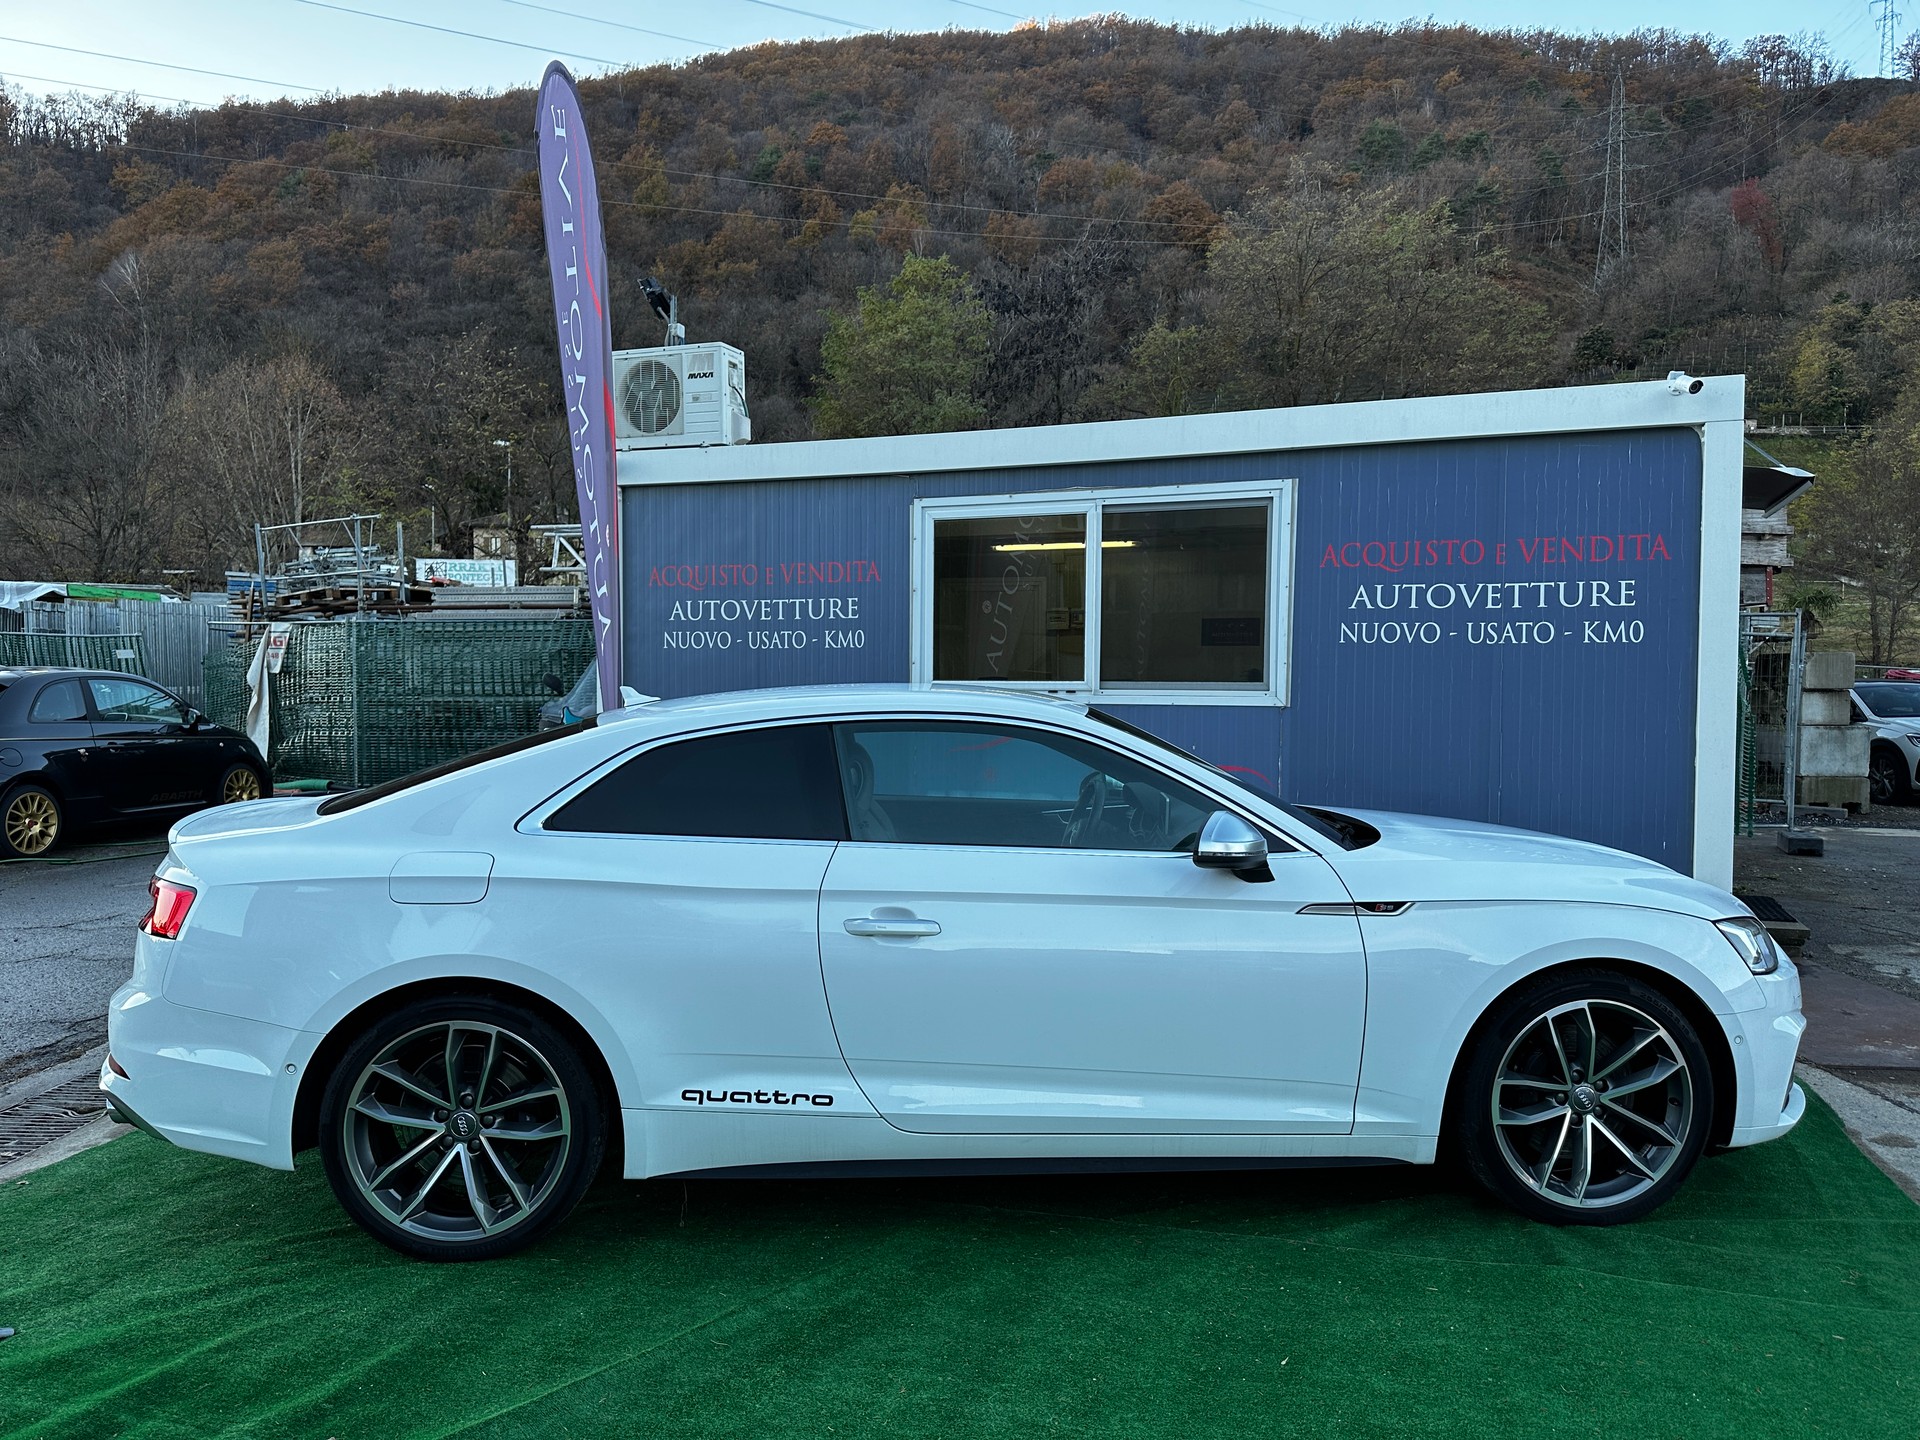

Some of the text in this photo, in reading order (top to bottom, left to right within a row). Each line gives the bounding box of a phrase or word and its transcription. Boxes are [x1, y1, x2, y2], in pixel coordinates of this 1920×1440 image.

[687, 371, 714, 380] MAXA
[1320, 539, 1485, 572] ACQUISTO
[1517, 533, 1672, 563] VENDITA
[649, 564, 758, 590] ACQUISTO
[780, 560, 881, 584] VENDITA
[1348, 580, 1636, 610] AUTOVETTURE
[669, 597, 859, 621] AUTOVETTURE
[663, 631, 731, 649] NUOVO
[748, 630, 806, 649] USATO
[1339, 621, 1441, 644] NUOVO
[1467, 621, 1555, 644] USATO
[149, 789, 204, 802] ABARTH
[681, 1089, 834, 1107] quattro
